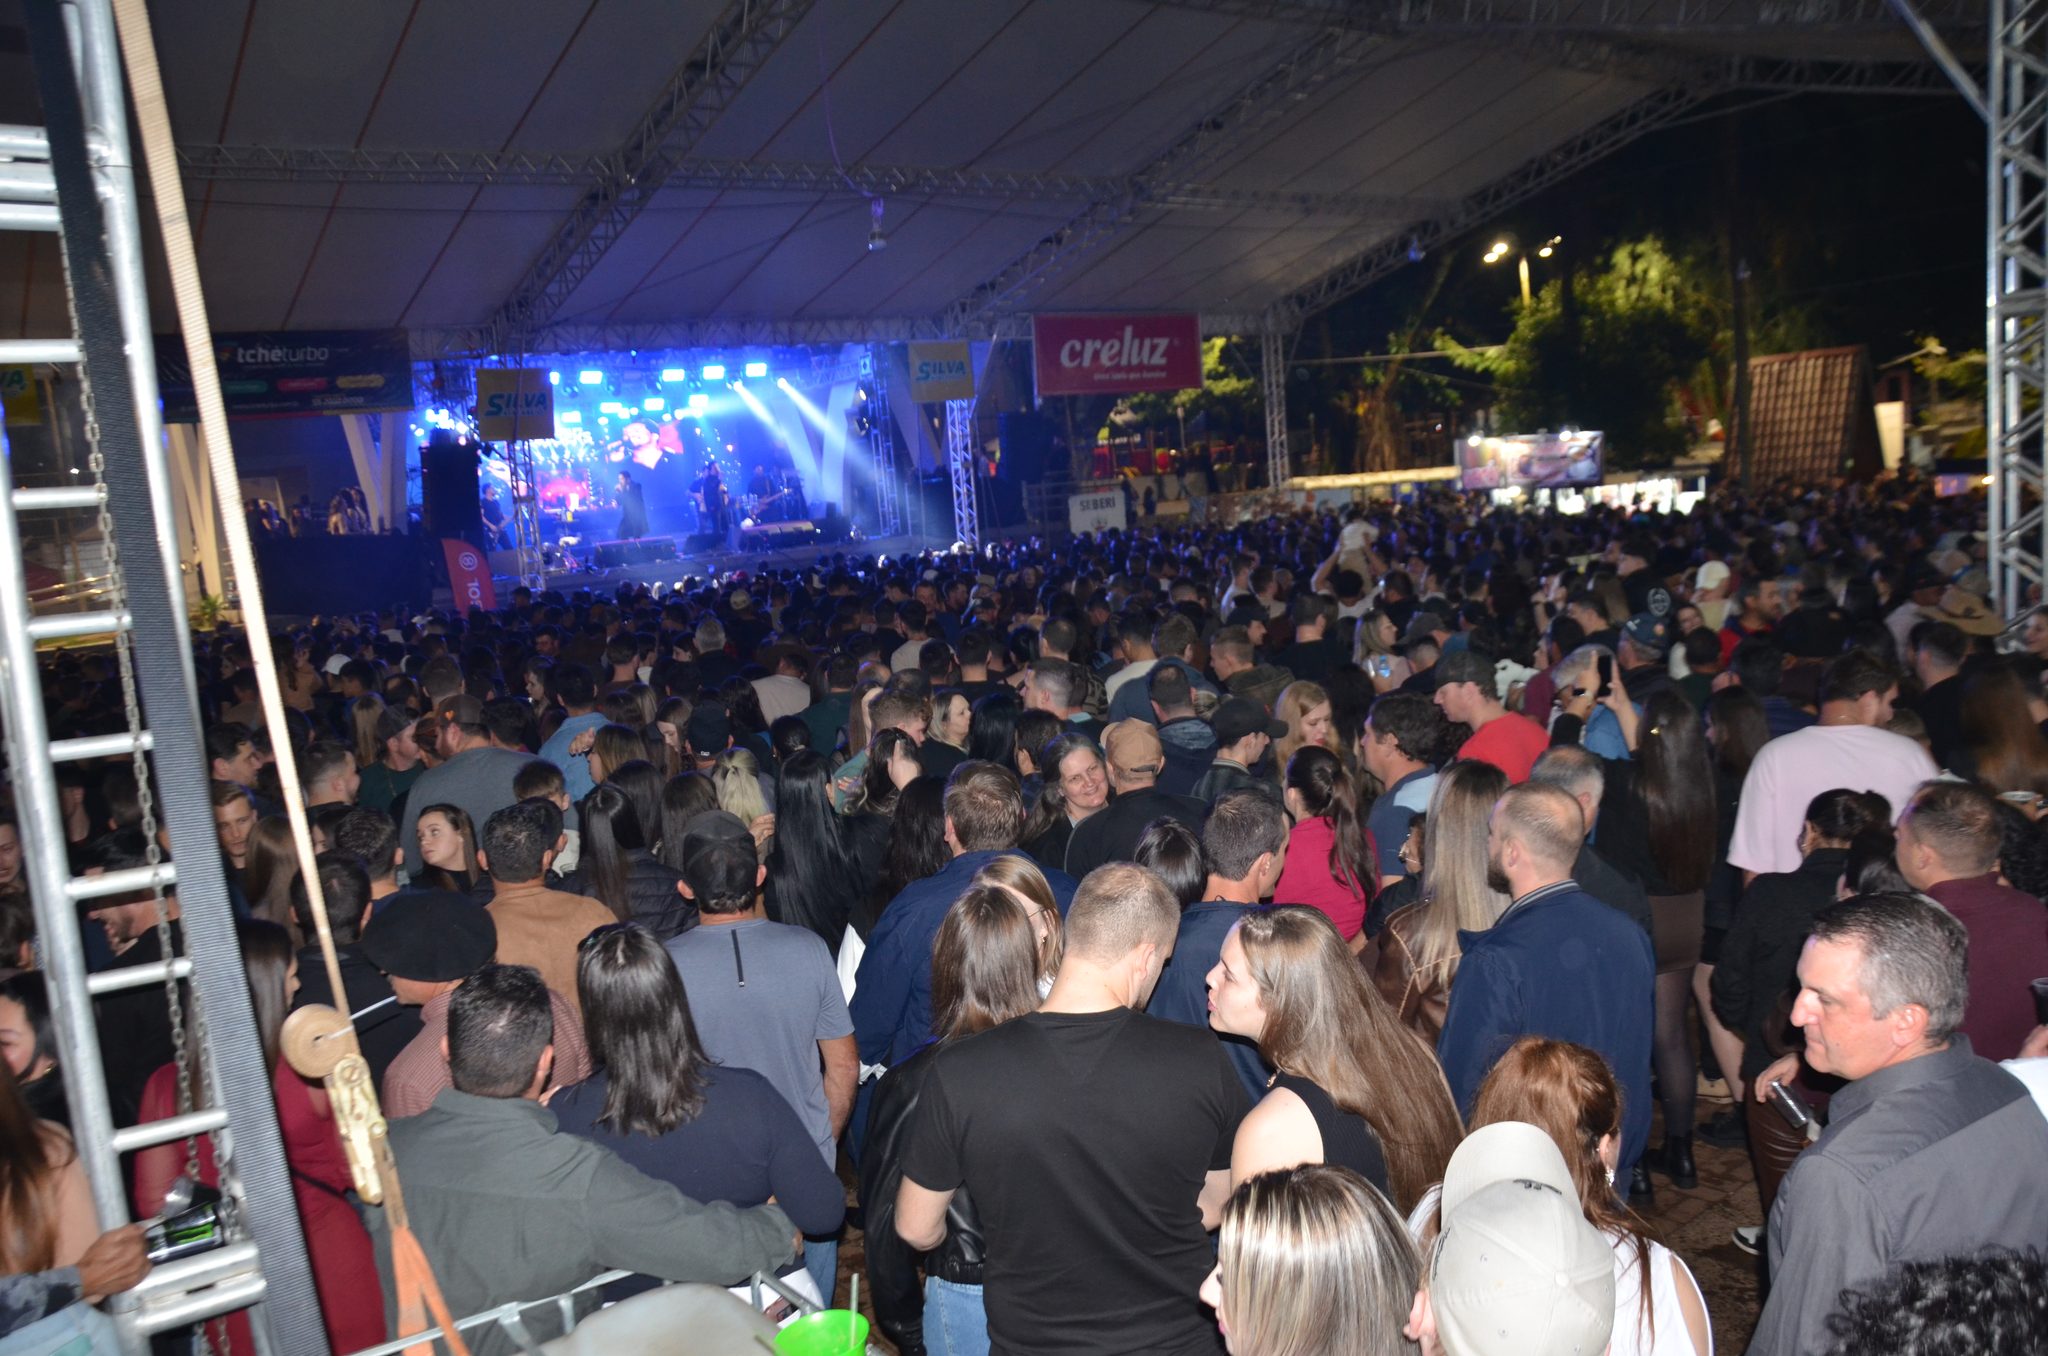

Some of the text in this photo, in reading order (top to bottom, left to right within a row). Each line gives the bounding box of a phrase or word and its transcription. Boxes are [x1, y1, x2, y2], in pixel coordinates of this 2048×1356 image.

[1060, 325, 1170, 368] creluz
[916, 361, 966, 381] SILVA
[485, 392, 548, 416] SILVA
[1080, 496, 1116, 511] SEBERI
